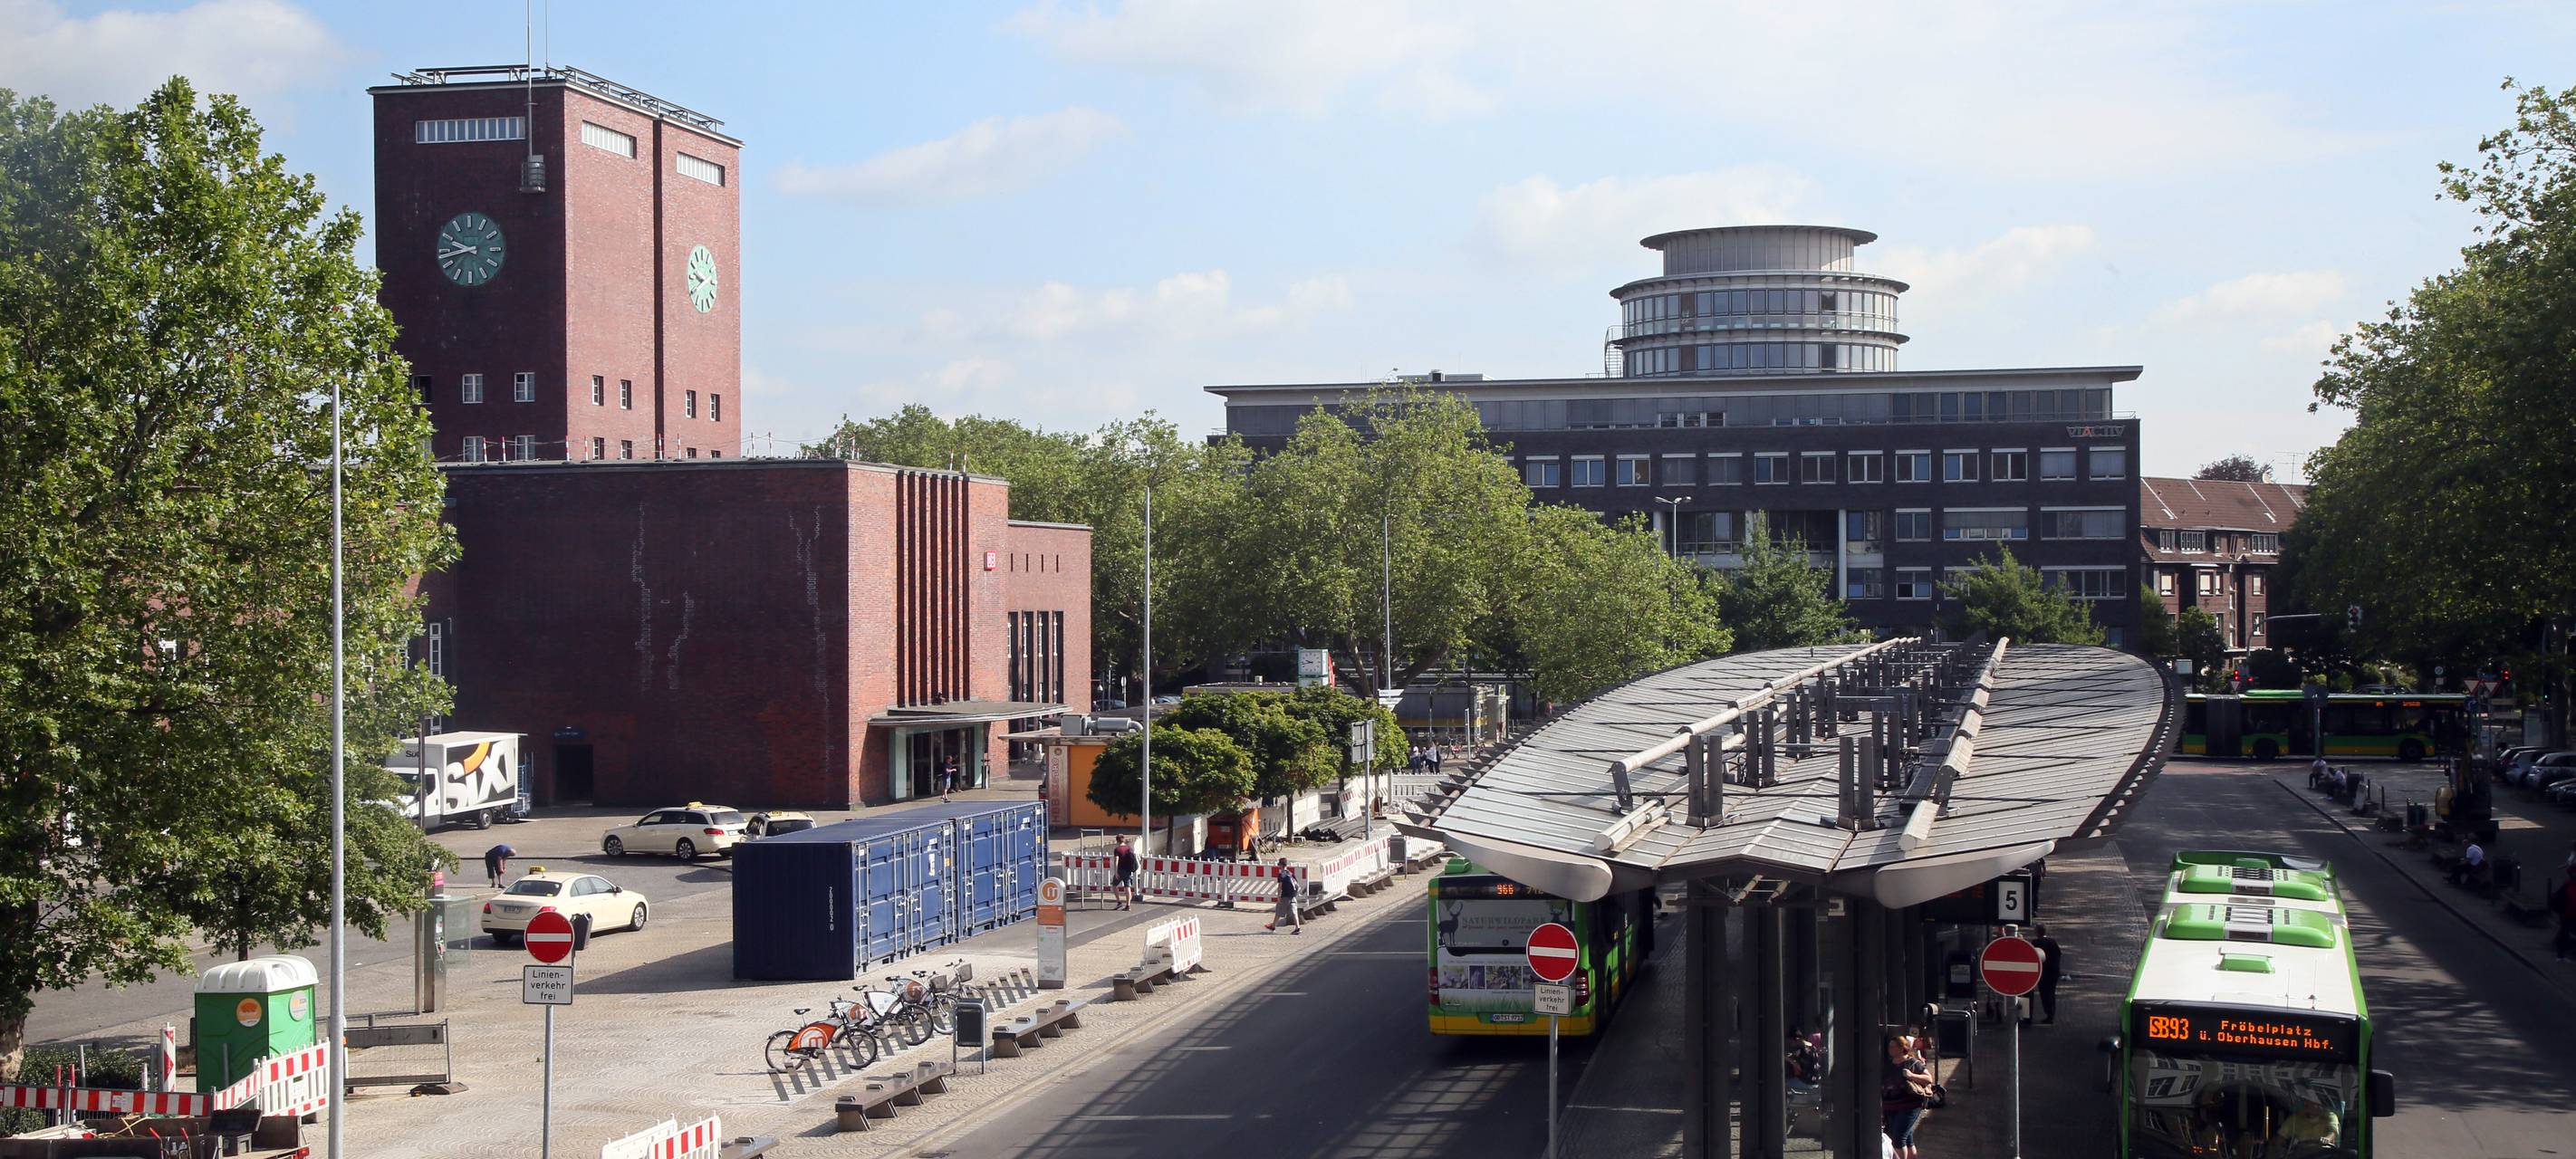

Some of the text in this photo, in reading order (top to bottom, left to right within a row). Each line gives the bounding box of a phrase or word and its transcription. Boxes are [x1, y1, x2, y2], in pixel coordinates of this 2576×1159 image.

[2004, 890, 2017, 911] 5
[533, 970, 564, 979] Linien-
[531, 981, 565, 990] verkehr
[1540, 986, 1563, 995] Linien-
[540, 991, 556, 1000] frei
[1539, 995, 1565, 1004] verkehr
[1546, 1003, 1558, 1011] frei
[2149, 1016, 2189, 1039] SB93
[2221, 1020, 2312, 1037] Fröbelplatz
[2199, 1030, 2334, 1050] ü. Oberhausen Hbf.
